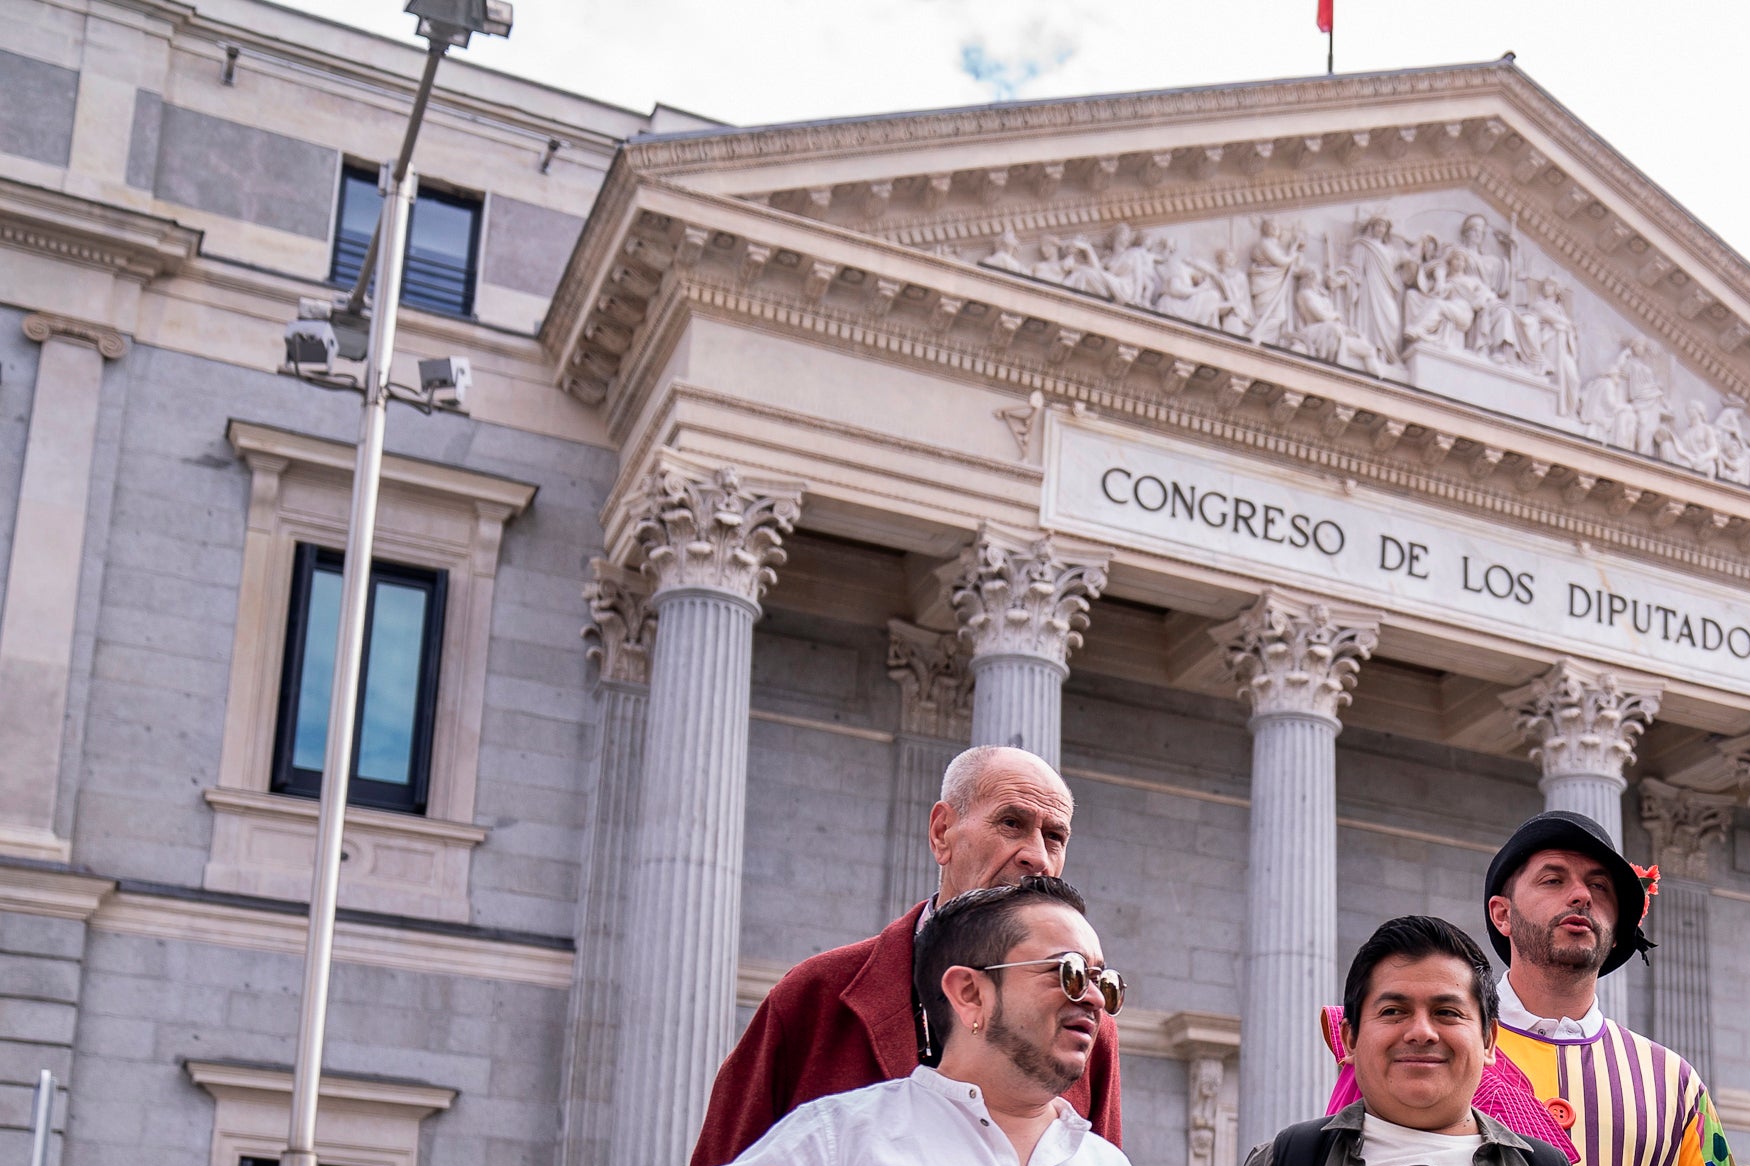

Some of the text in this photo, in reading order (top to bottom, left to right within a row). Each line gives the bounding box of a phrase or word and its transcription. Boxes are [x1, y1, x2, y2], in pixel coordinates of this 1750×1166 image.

[1101, 467, 1346, 556] CONGRESO
[1379, 533, 1430, 580] DE
[1462, 555, 1536, 605] LOS
